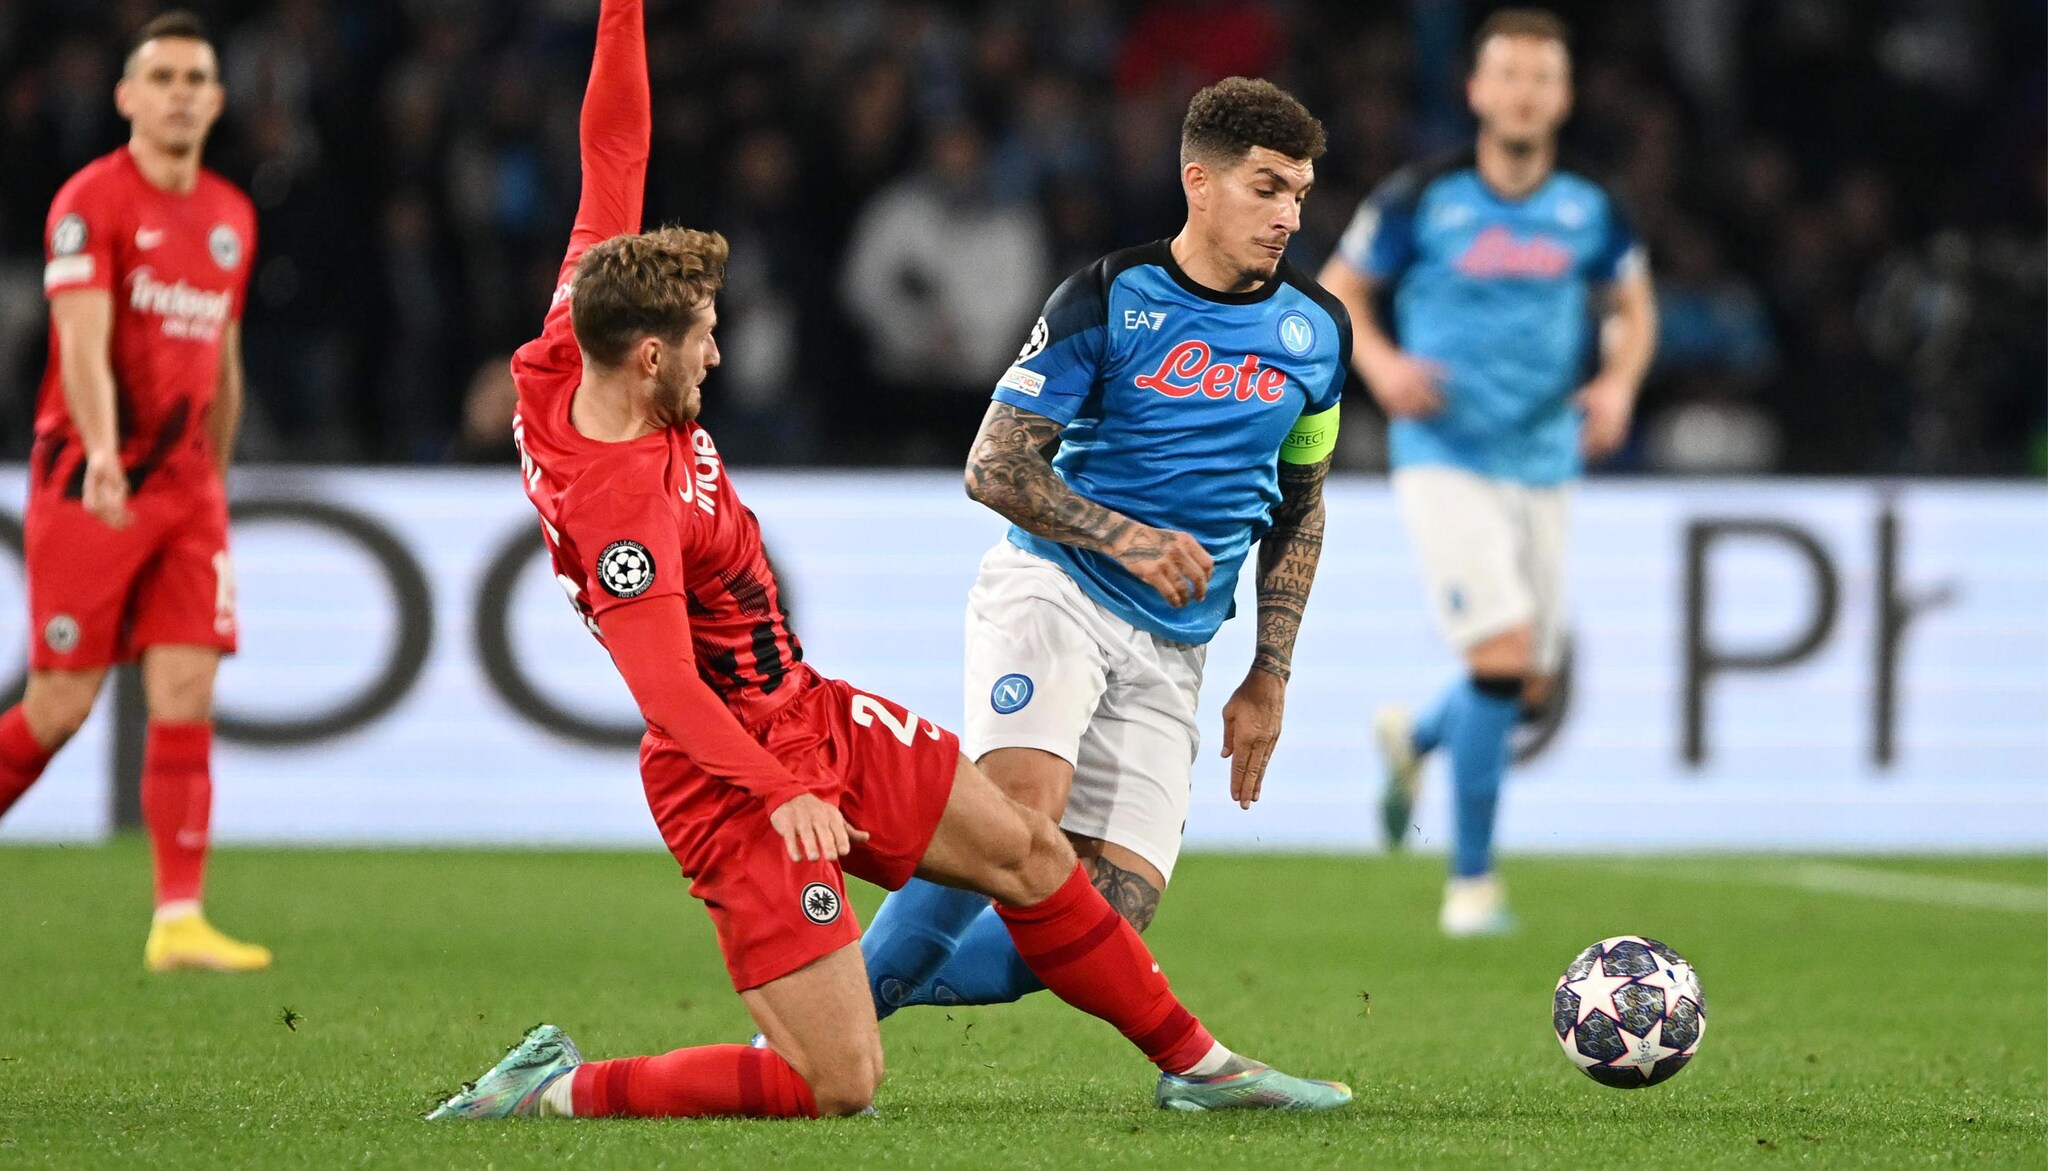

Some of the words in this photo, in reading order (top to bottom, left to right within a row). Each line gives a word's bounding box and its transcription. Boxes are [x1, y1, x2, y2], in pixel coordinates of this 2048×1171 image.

[1124, 310, 1167, 331] EA7
[1288, 321, 1305, 347] N
[1135, 339, 1287, 403] Lete
[1285, 430, 1326, 445] SPECT
[599, 542, 620, 562] EUROPA
[620, 540, 645, 551] LEAGUE
[1000, 682, 1022, 703] N
[851, 694, 920, 748] 2
